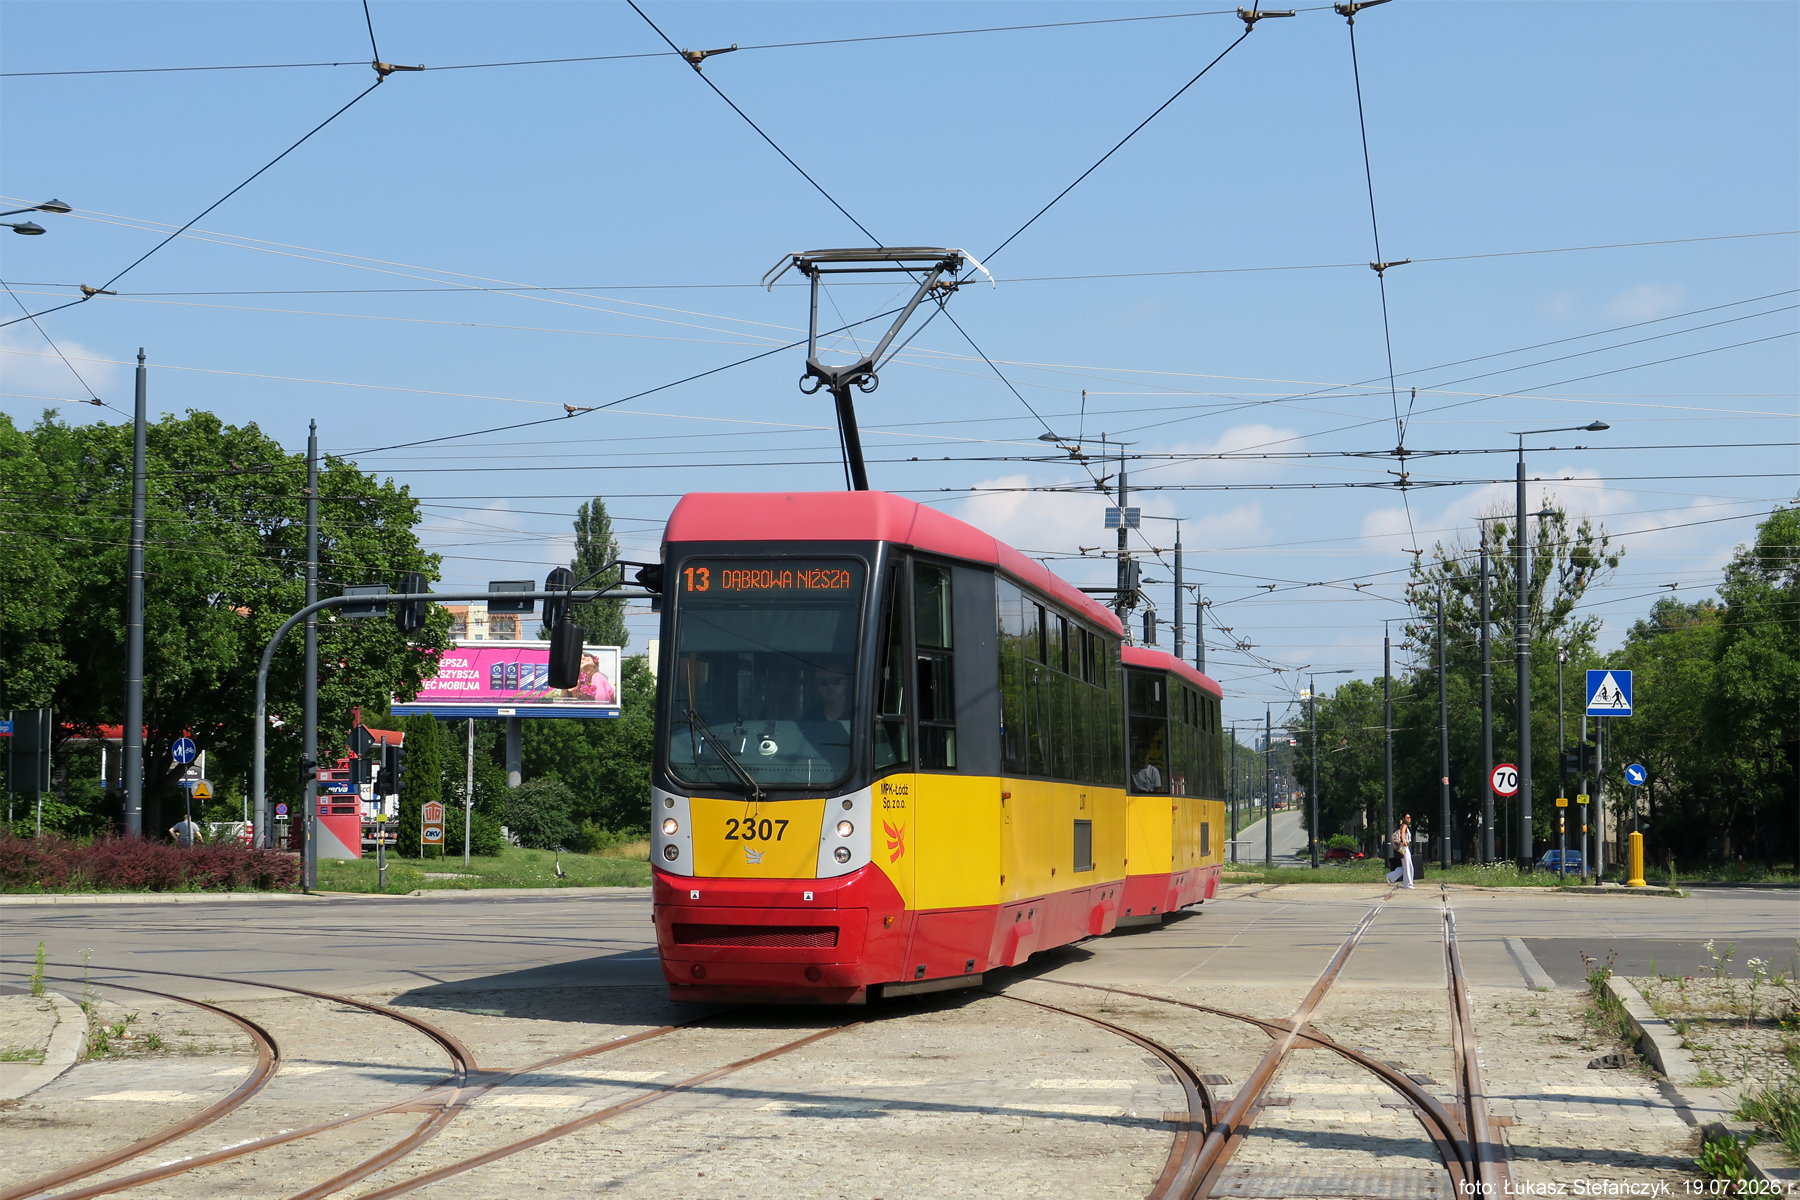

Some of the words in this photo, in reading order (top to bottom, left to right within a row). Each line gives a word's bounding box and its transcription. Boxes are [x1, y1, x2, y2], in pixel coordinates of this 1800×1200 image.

[683, 567, 710, 592] 13
[722, 569, 792, 592] DĄBROWA
[797, 568, 850, 589] NIŻSZA
[438, 681, 480, 690] MOBILNA
[1496, 772, 1517, 788] 70
[880, 783, 909, 796] MPK-Łódź
[425, 830, 440, 838] DKV
[725, 817, 789, 841] 2307
